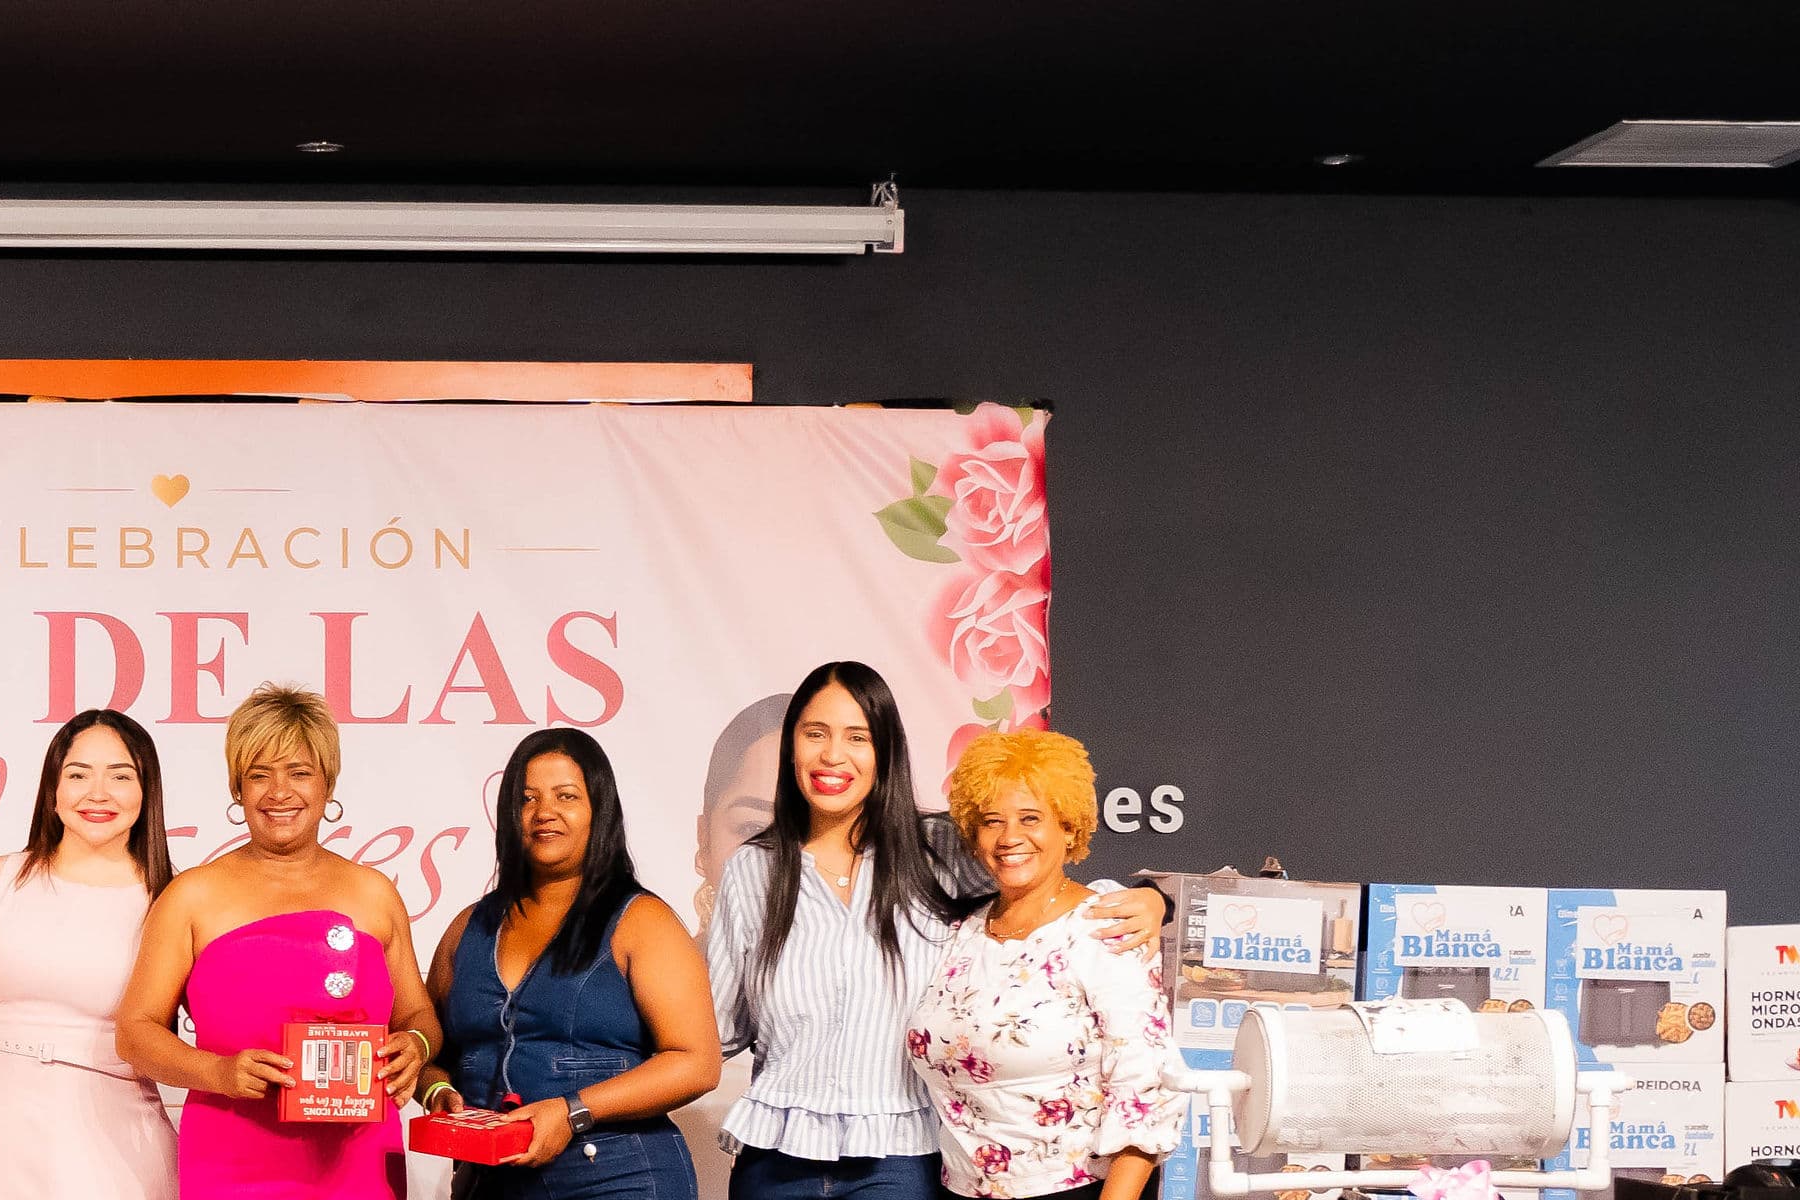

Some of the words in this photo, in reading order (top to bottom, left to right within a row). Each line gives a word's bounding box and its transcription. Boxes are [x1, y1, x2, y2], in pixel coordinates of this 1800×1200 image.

[34, 612, 252, 724] DE
[315, 610, 624, 727] LAS
[1245, 932, 1303, 948] Mamá
[1435, 929, 1492, 942] Mamá
[1210, 936, 1312, 963] Blanca
[1401, 935, 1501, 958] Blanca
[1617, 943, 1674, 955] Mamá
[1582, 948, 1683, 971] Blanca
[1637, 1080, 1701, 1092] REIDORA
[303, 1107, 330, 1116] ICONS
[333, 1108, 368, 1117] BEAUTY
[1609, 1121, 1666, 1134] Mamá
[1575, 1127, 1676, 1149] Banca
